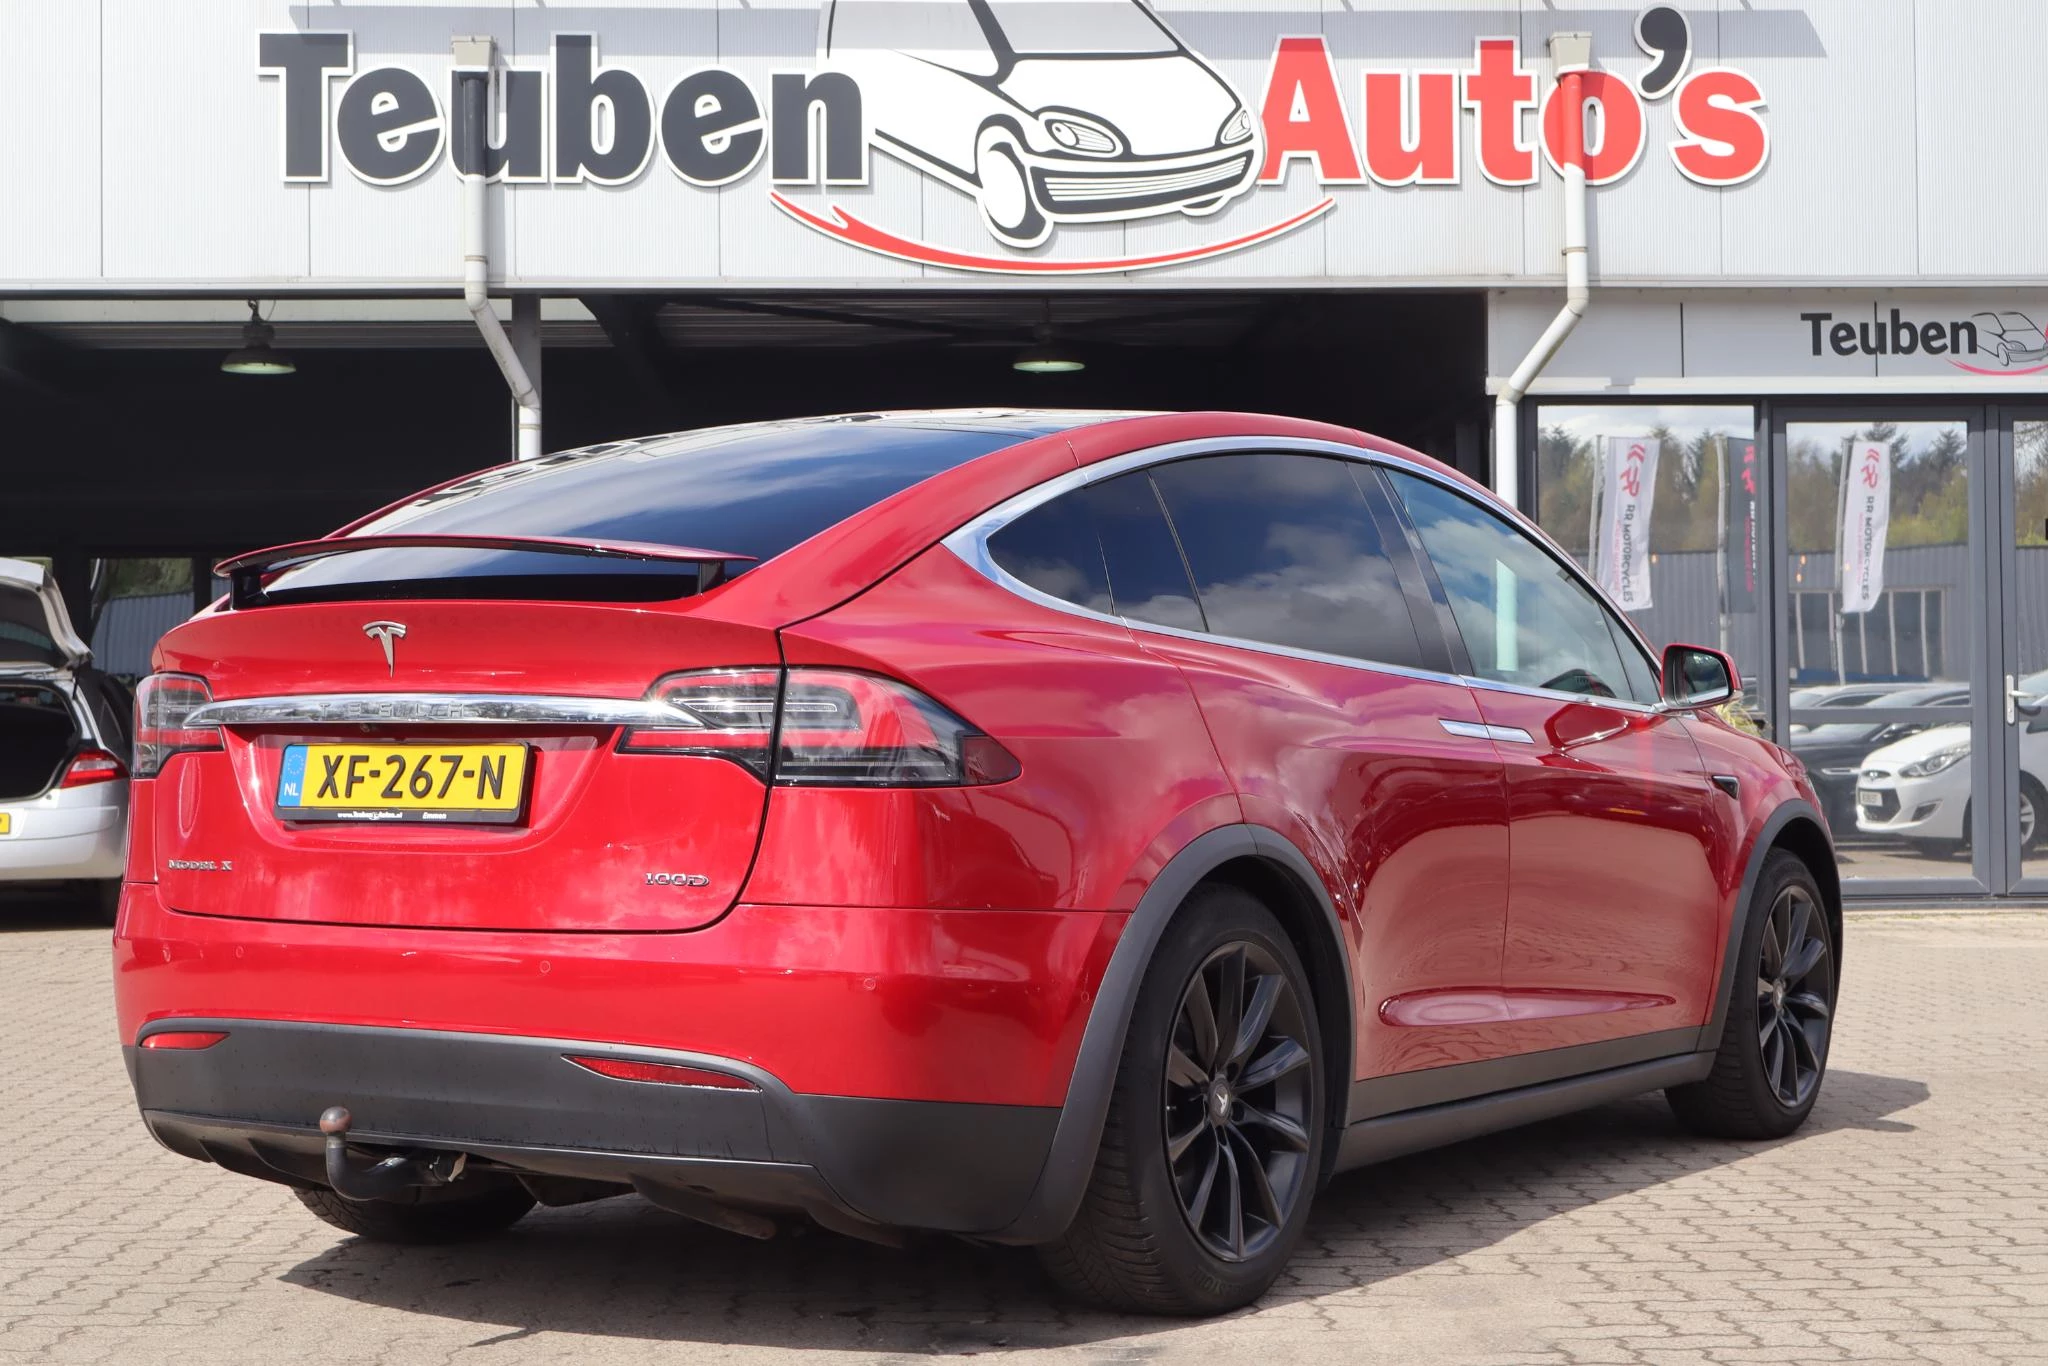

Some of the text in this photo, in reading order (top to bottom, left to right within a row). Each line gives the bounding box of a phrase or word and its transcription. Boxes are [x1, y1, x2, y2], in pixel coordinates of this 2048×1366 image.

[259, 5, 1768, 184] Teuben Auto's
[1800, 309, 1978, 356] Teuben
[1620, 524, 1635, 603] MOTORCYCLES
[1861, 517, 1874, 601] MOTORCYCLES
[319, 703, 465, 720] TESLA
[284, 782, 299, 796] NL
[317, 754, 507, 799] XF-267-N
[168, 860, 232, 871] MODEL X
[646, 872, 710, 887] 100D
